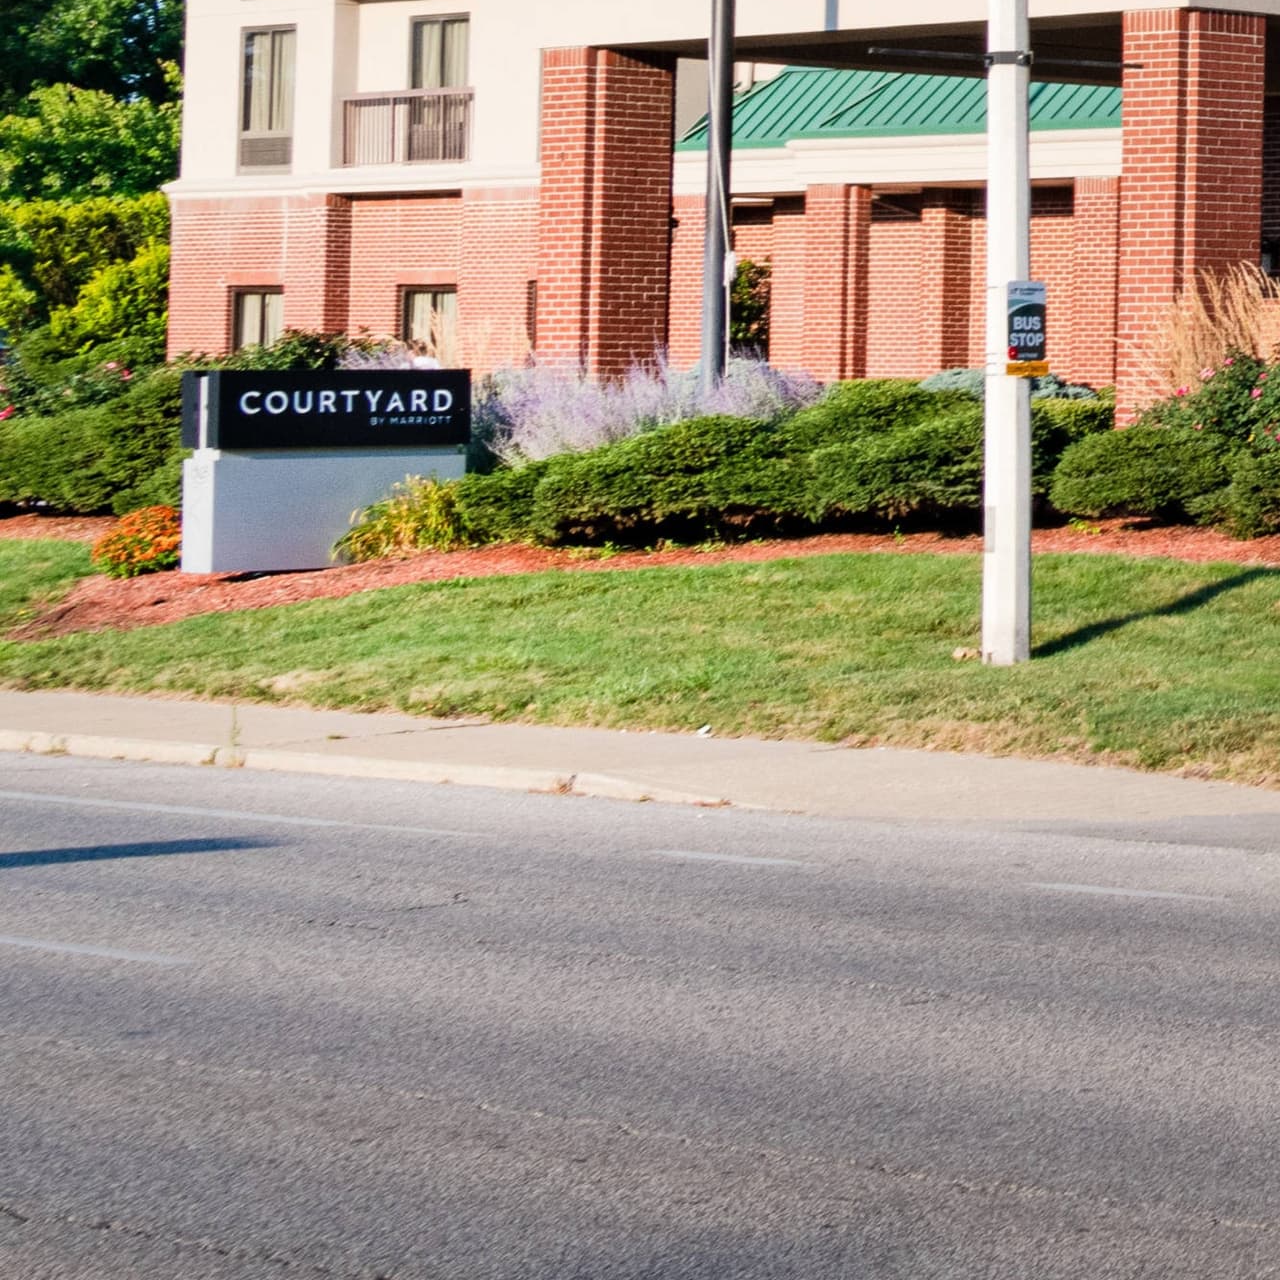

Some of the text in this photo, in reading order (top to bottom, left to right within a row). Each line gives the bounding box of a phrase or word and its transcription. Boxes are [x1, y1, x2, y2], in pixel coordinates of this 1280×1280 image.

[1013, 316, 1041, 330] BUS
[1010, 333, 1044, 346] STOP
[239, 389, 453, 415] COURTYARD
[370, 415, 452, 426] BY MARRIOTT
